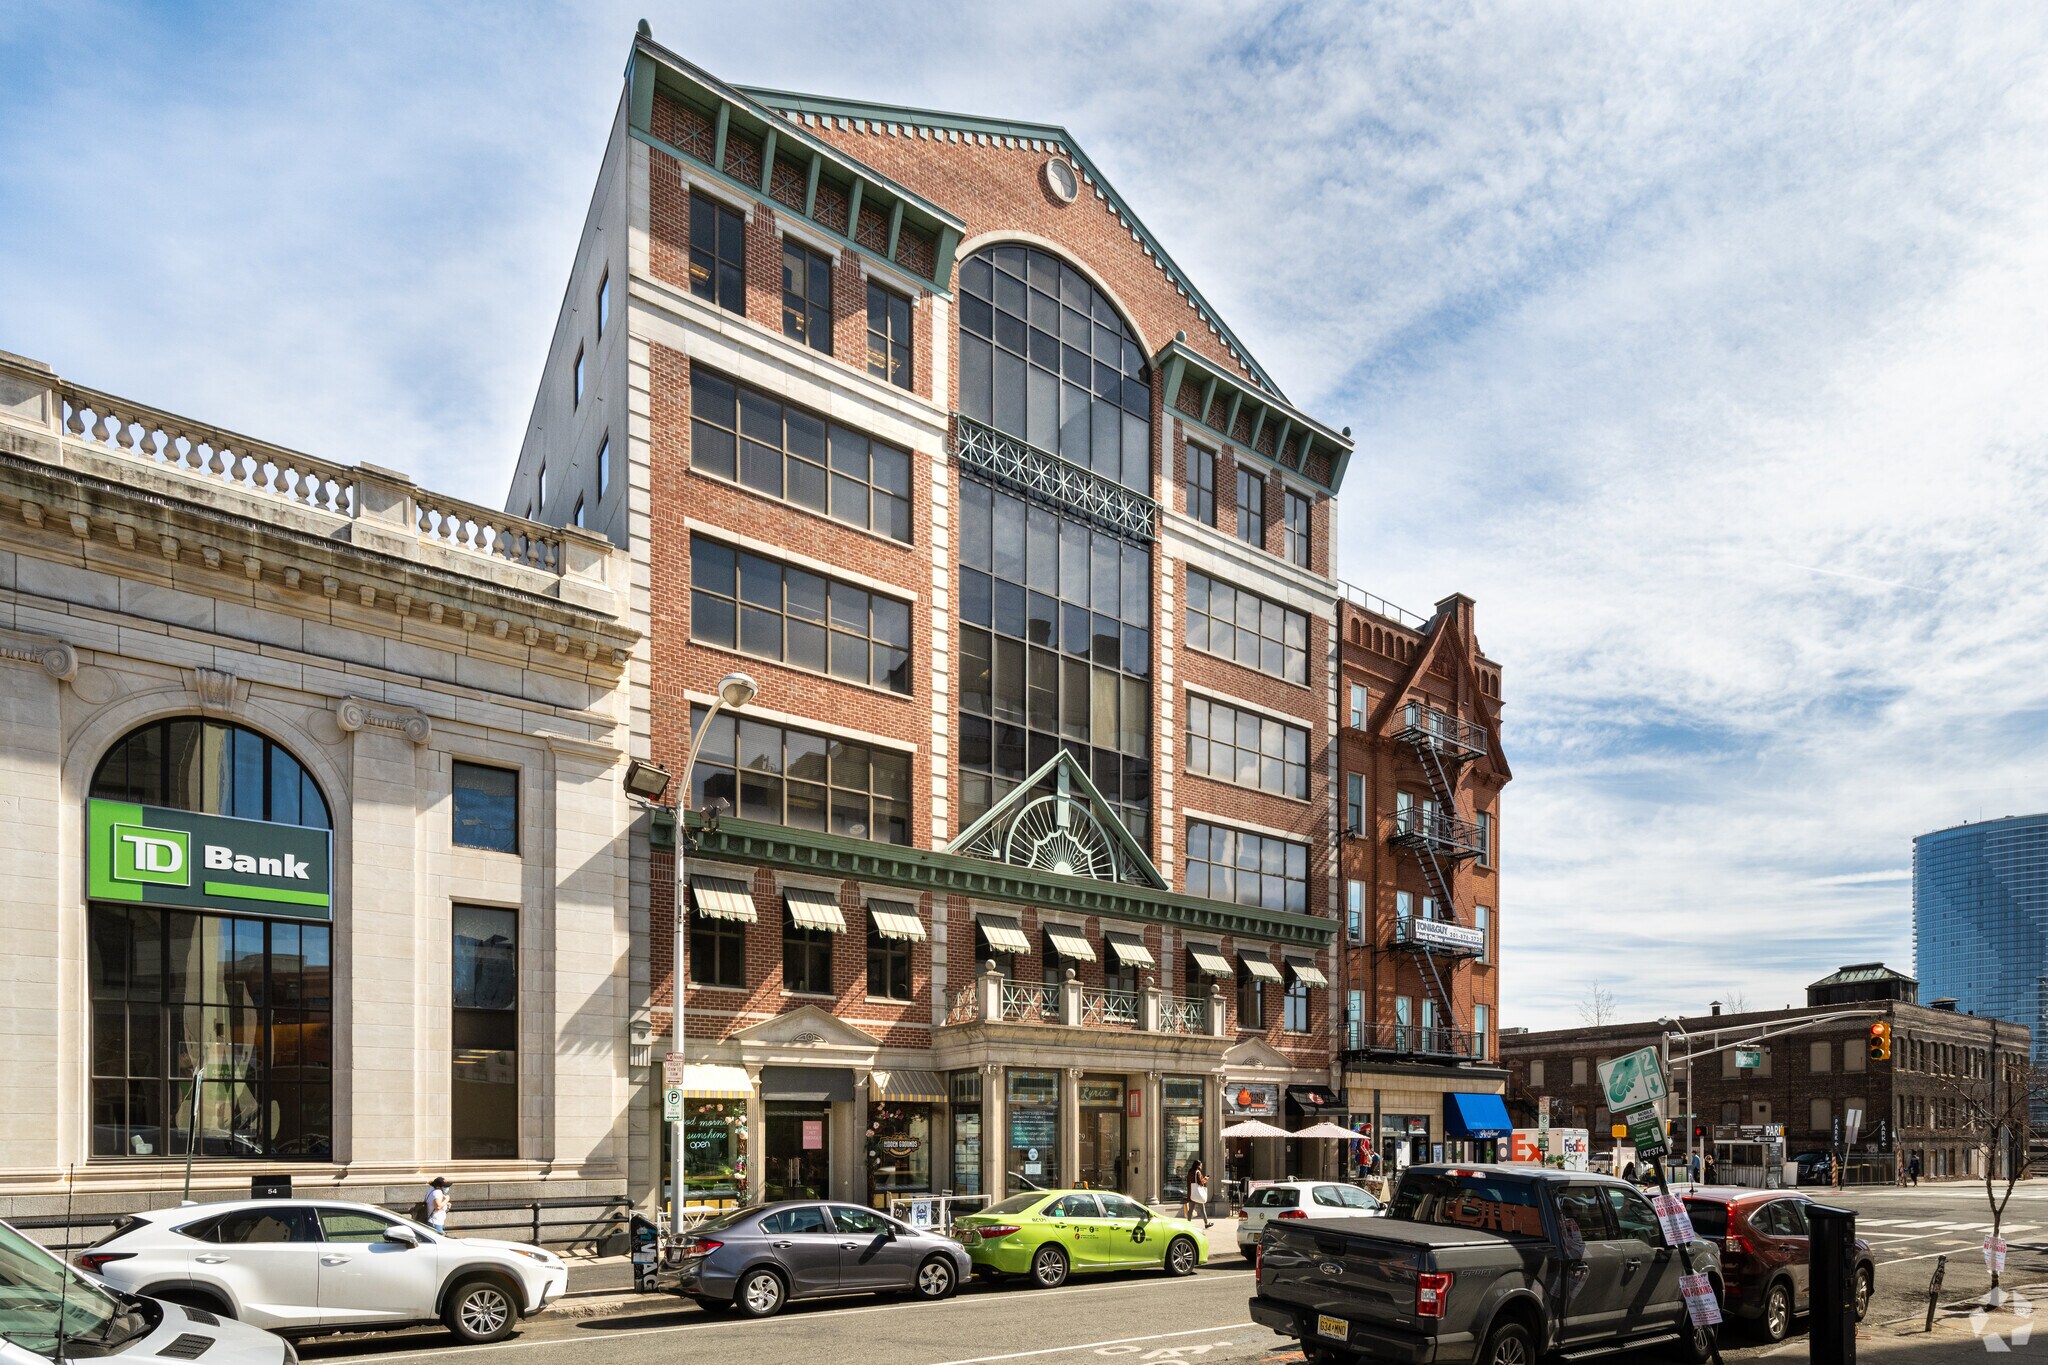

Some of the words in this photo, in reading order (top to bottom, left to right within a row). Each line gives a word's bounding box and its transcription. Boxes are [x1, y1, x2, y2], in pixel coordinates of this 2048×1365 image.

[121, 834, 183, 873] TD
[204, 844, 310, 880] Bank
[1416, 921, 1448, 935] TONI&GUY
[1641, 1051, 1654, 1071] 2
[1080, 1087, 1110, 1100] Lyric
[686, 1129, 727, 1140] sunshine
[690, 1141, 710, 1150] open
[1564, 1138, 1586, 1153] FedEx
[1656, 1209, 1666, 1217] NO
[1682, 1288, 1691, 1298] NO
